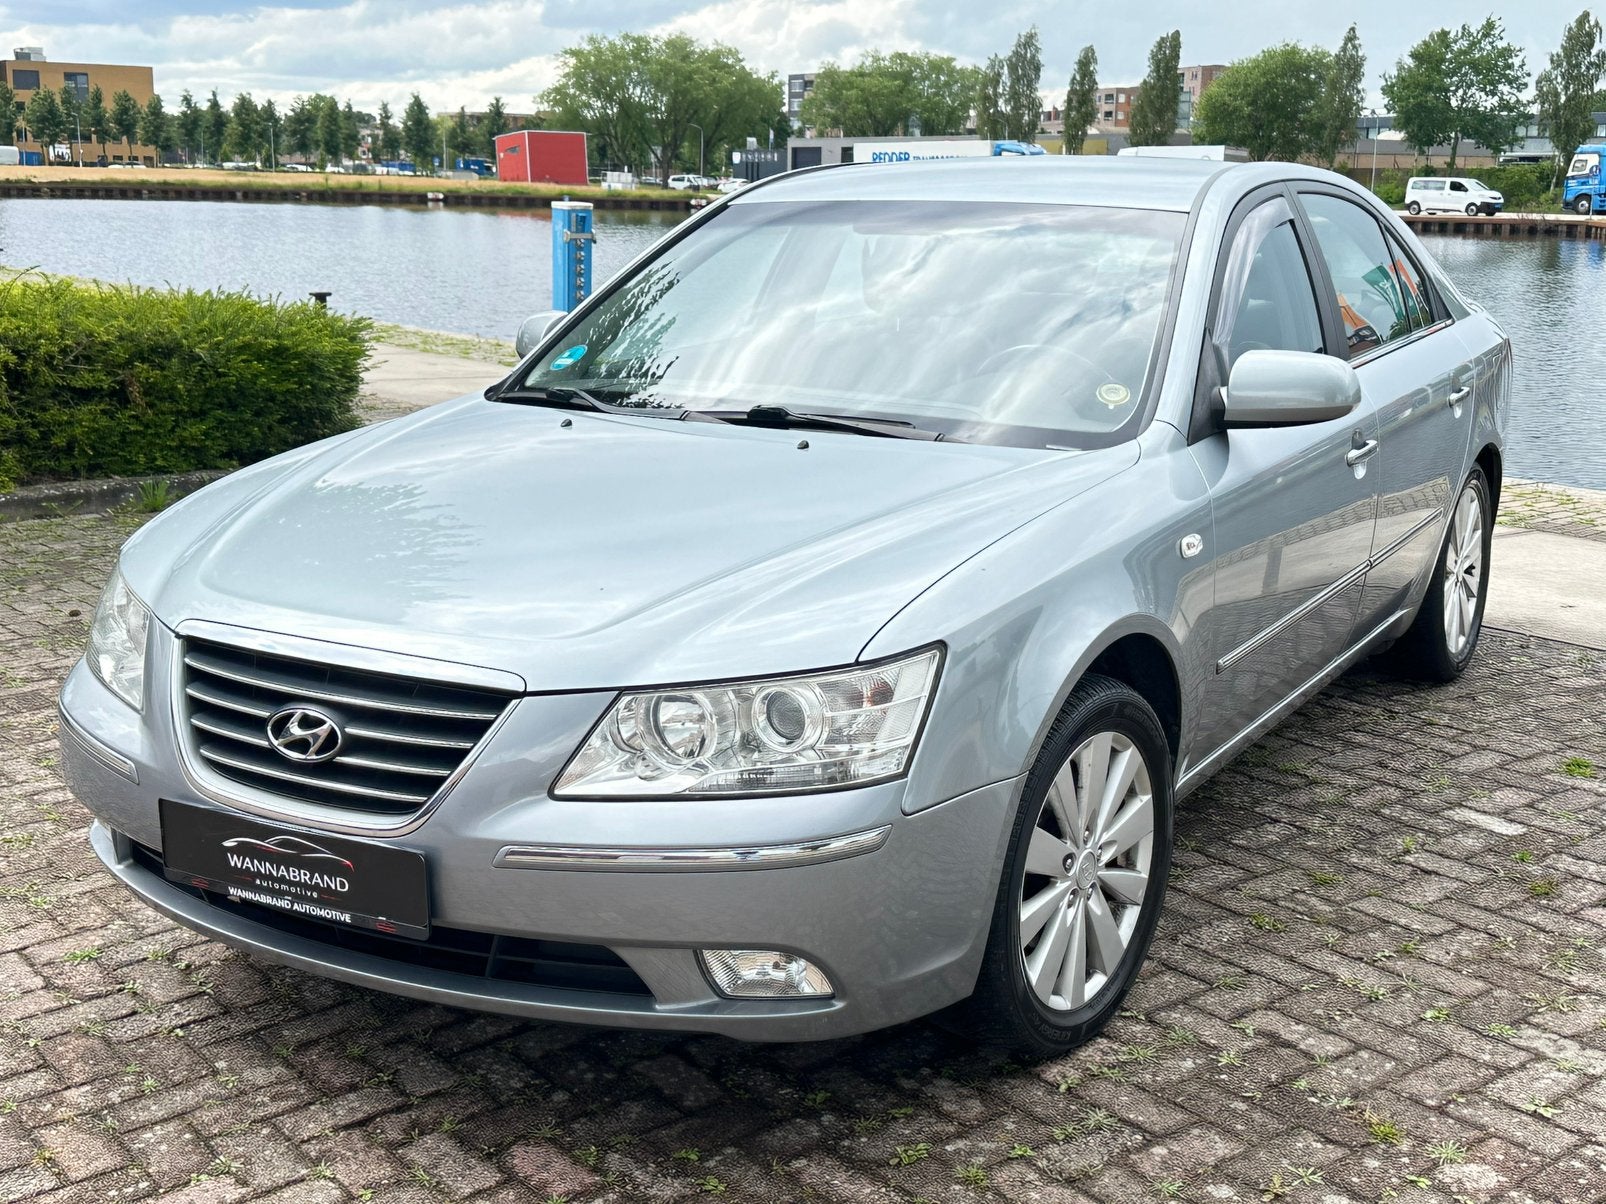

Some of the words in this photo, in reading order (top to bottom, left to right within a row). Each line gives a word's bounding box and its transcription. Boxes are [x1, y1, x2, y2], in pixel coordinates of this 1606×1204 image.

[227, 852, 349, 892] WANNABRAND
[255, 878, 318, 899] automotive
[228, 886, 292, 909] WANNABRAND
[293, 902, 352, 923] AUTOMOTIVE
